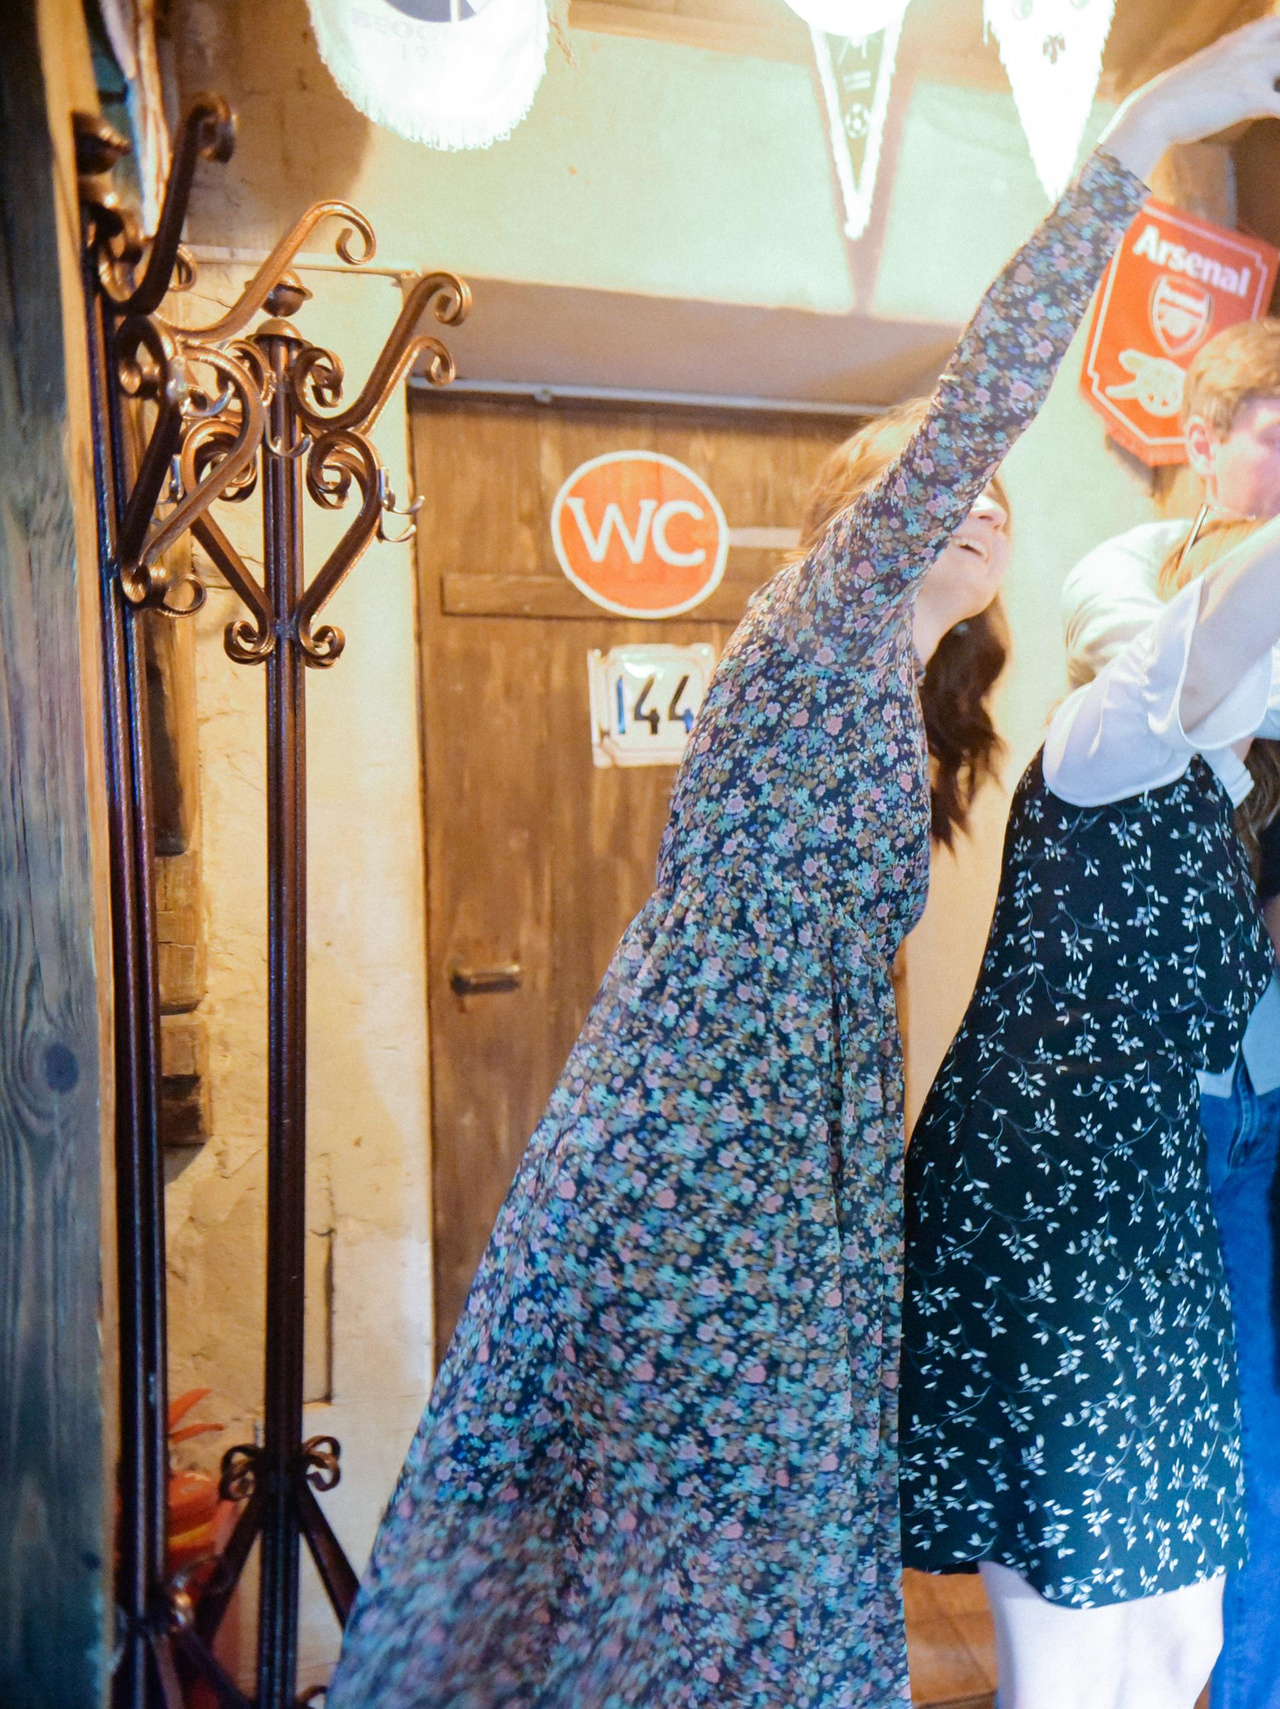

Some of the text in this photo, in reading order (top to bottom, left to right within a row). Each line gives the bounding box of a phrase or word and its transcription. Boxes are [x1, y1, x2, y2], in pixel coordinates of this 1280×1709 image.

[1132, 223, 1251, 298] Arsenal
[566, 496, 706, 567] WC
[616, 674, 694, 734] 144
